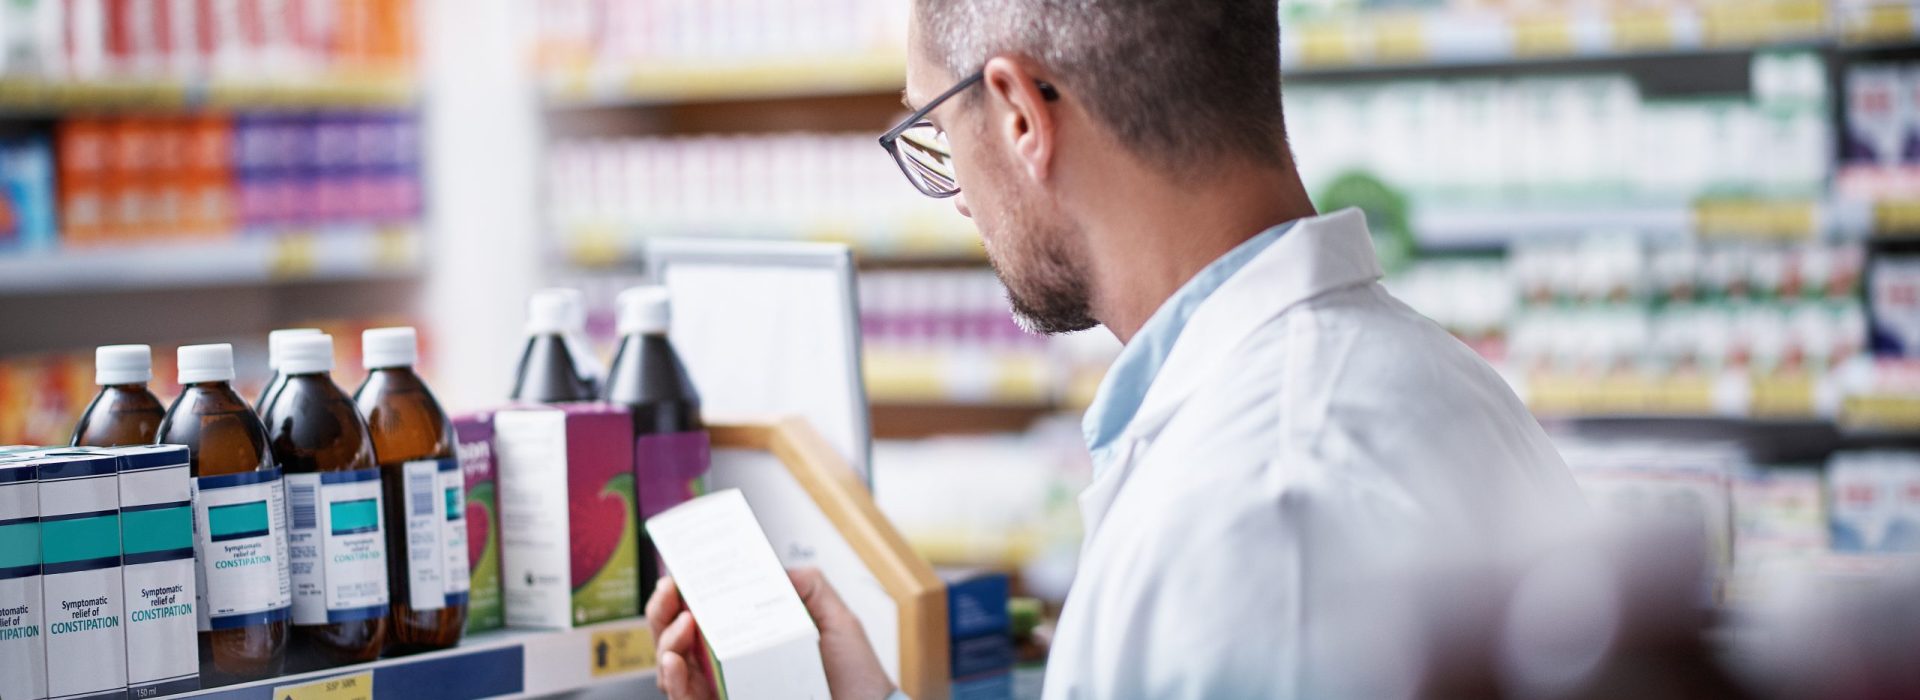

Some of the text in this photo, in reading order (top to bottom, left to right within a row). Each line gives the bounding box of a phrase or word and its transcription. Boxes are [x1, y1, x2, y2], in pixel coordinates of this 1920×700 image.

[215, 555, 271, 569] CONSTIPATION
[141, 584, 183, 598] Symptomatic
[61, 596, 108, 611] Symptomatic
[151, 595, 175, 606] relief of
[72, 607, 100, 618] relief of
[131, 603, 193, 622] CONSTIPATION
[12, 615, 20, 625] of
[51, 615, 119, 634] CONSTIPATION
[137, 687, 157, 698] 150 ml
